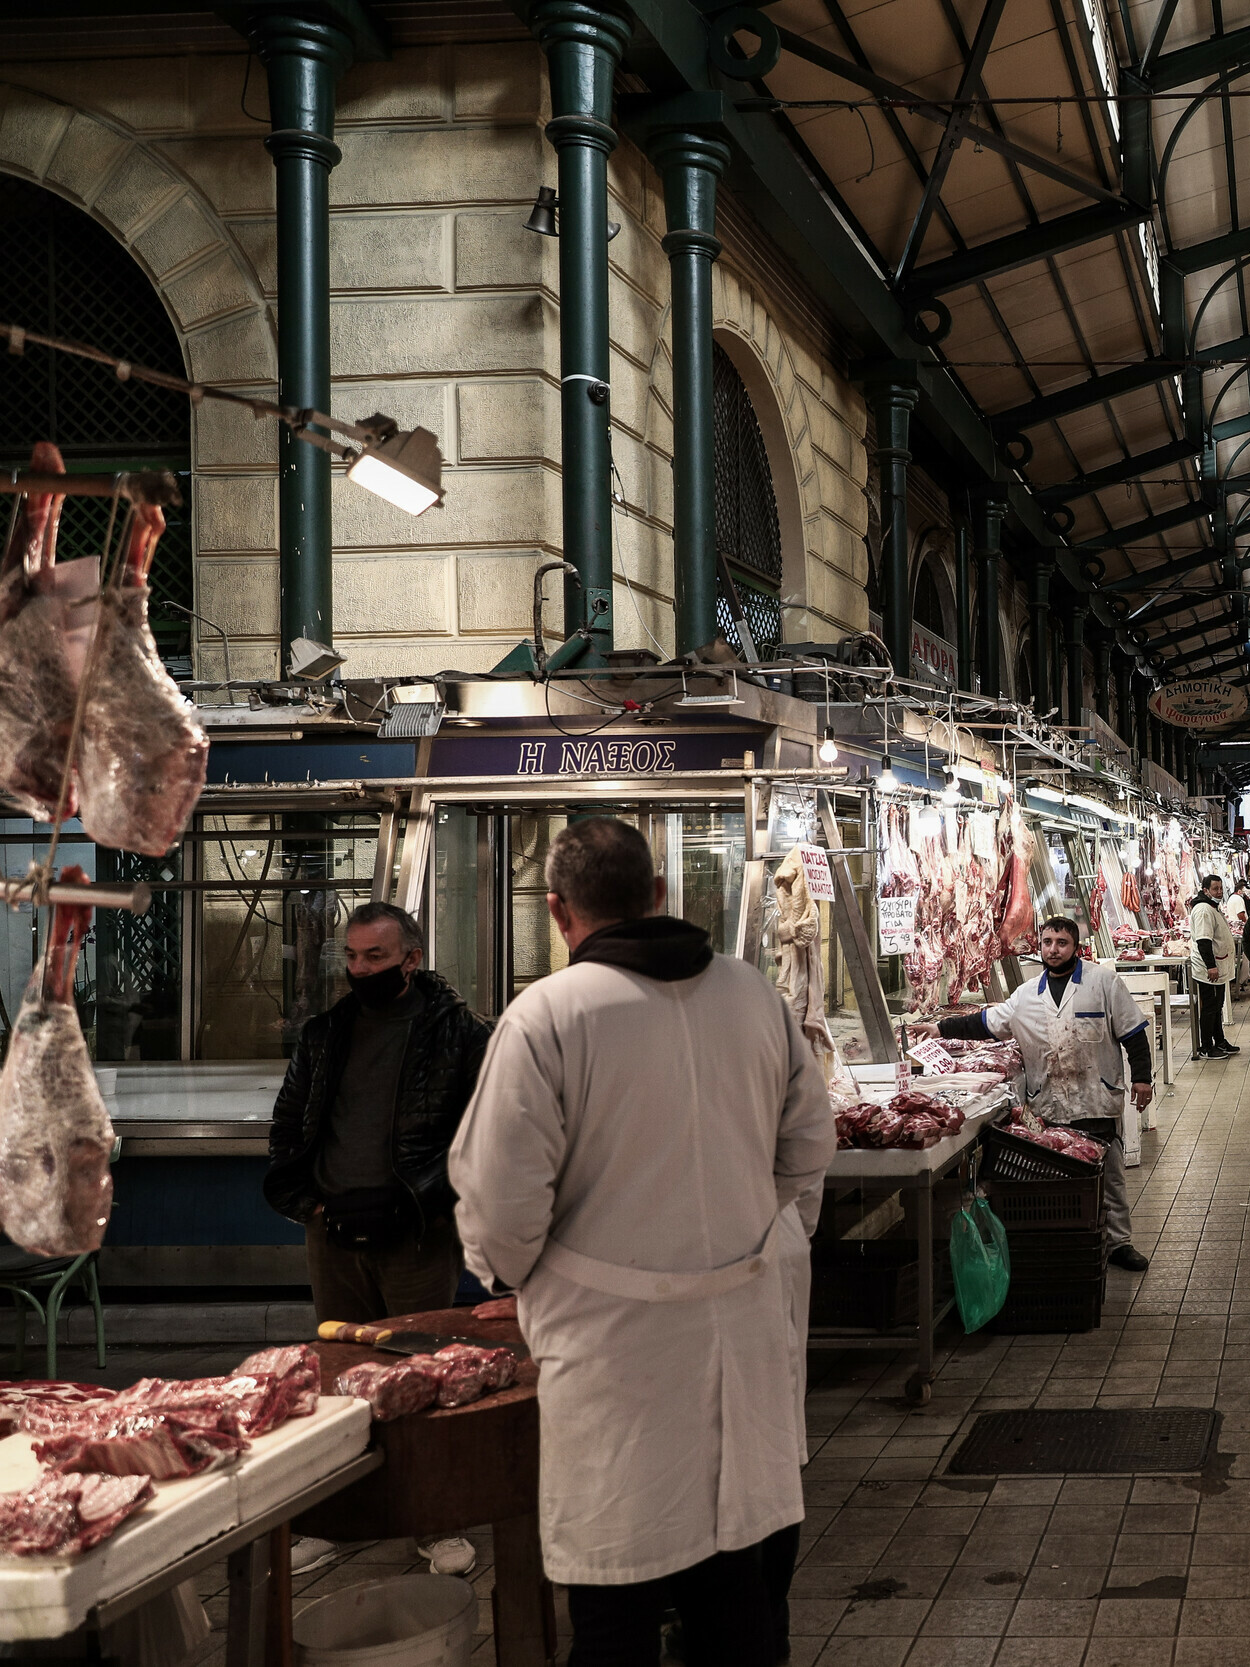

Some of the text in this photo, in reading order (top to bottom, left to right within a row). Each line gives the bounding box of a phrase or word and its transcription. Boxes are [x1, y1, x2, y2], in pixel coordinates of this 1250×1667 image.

[912, 632, 956, 680] ΑΓΟΡΑ
[1165, 682, 1232, 698] ΔΗΜΟΤΙΚΗ
[517, 741, 676, 774] Η ΝΑΞΟΣ
[800, 850, 828, 867] ΠΑΤΣΑΣ
